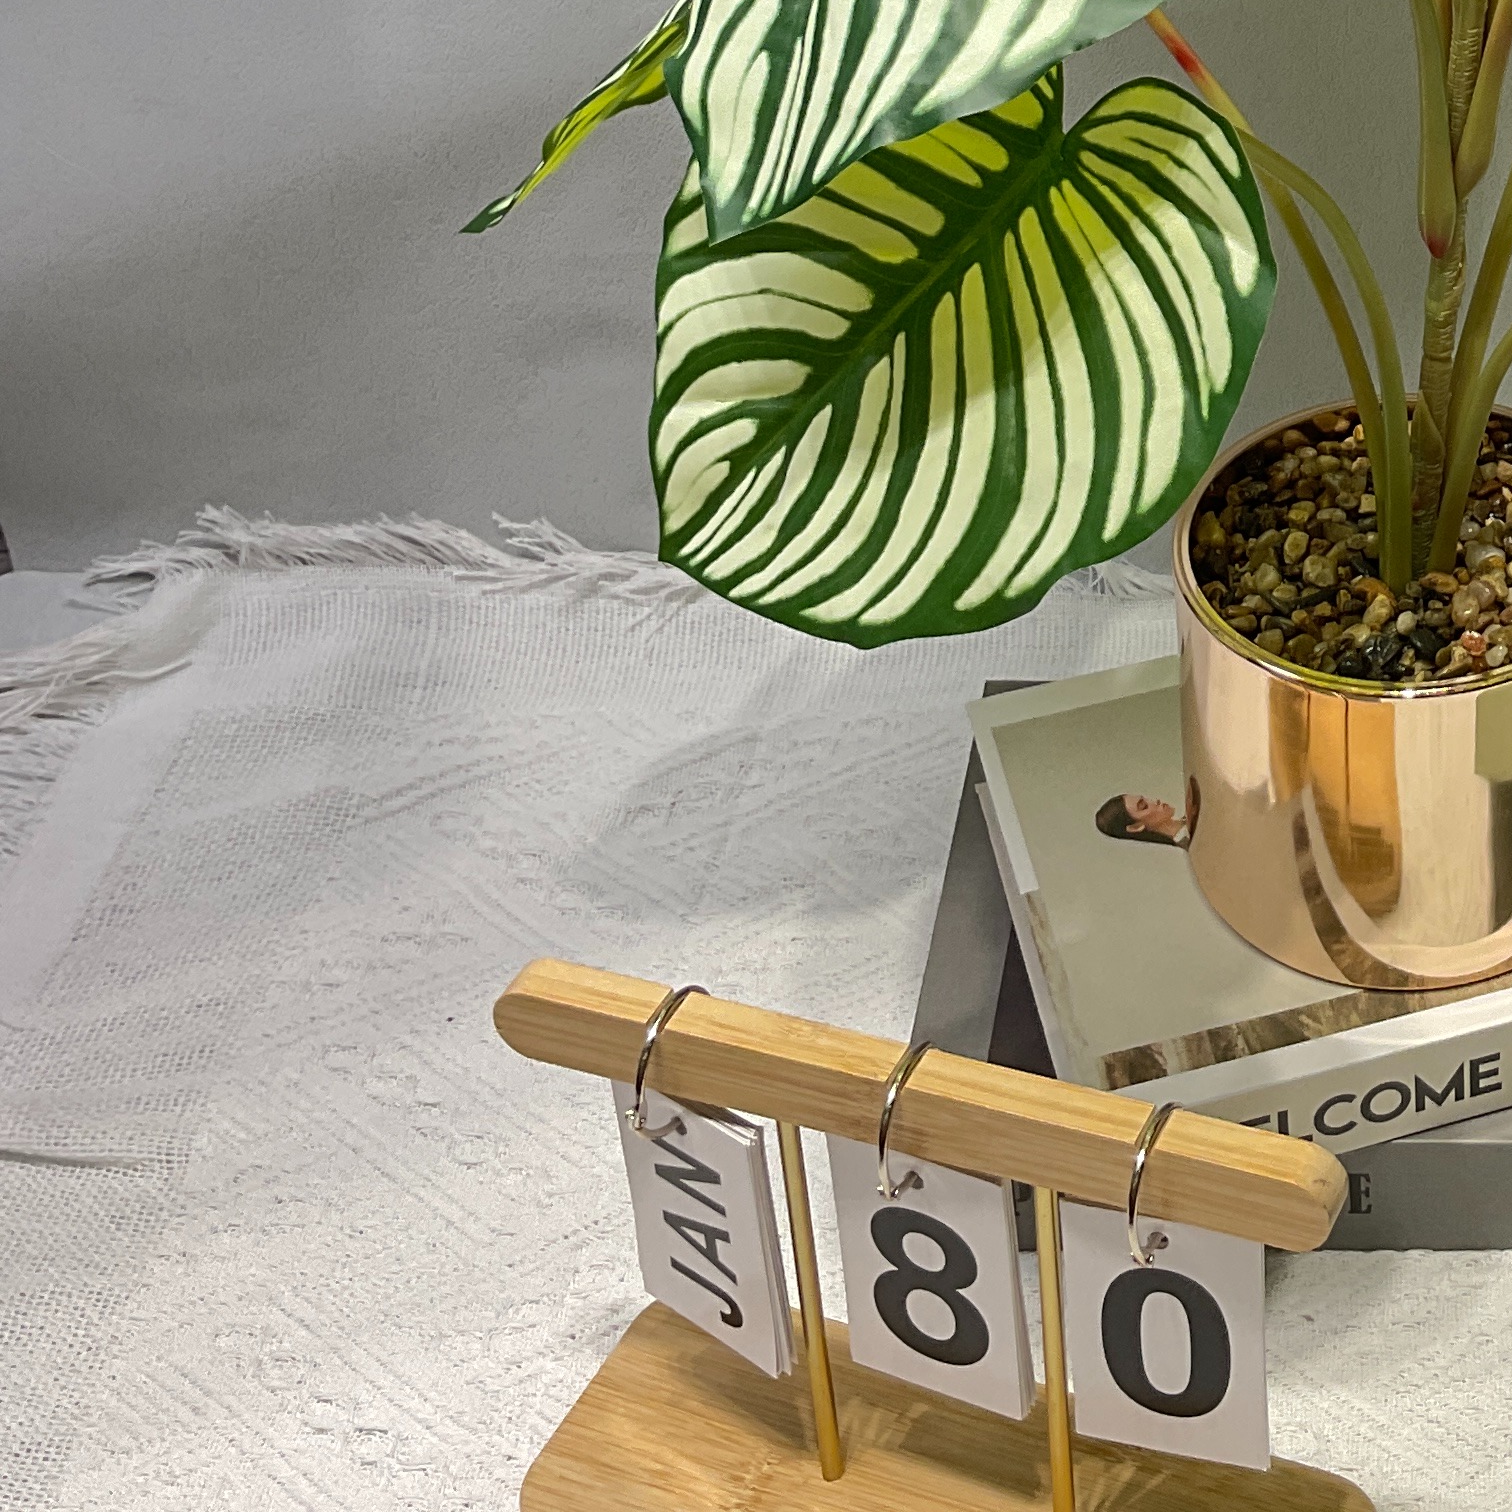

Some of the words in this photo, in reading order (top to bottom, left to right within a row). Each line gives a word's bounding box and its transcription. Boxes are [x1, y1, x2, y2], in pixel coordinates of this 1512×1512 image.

[1238, 1052, 1502, 1142] LCOME
[651, 1137, 743, 1328] JAN
[870, 1206, 990, 1366] 8
[1101, 1267, 1231, 1417] 0
